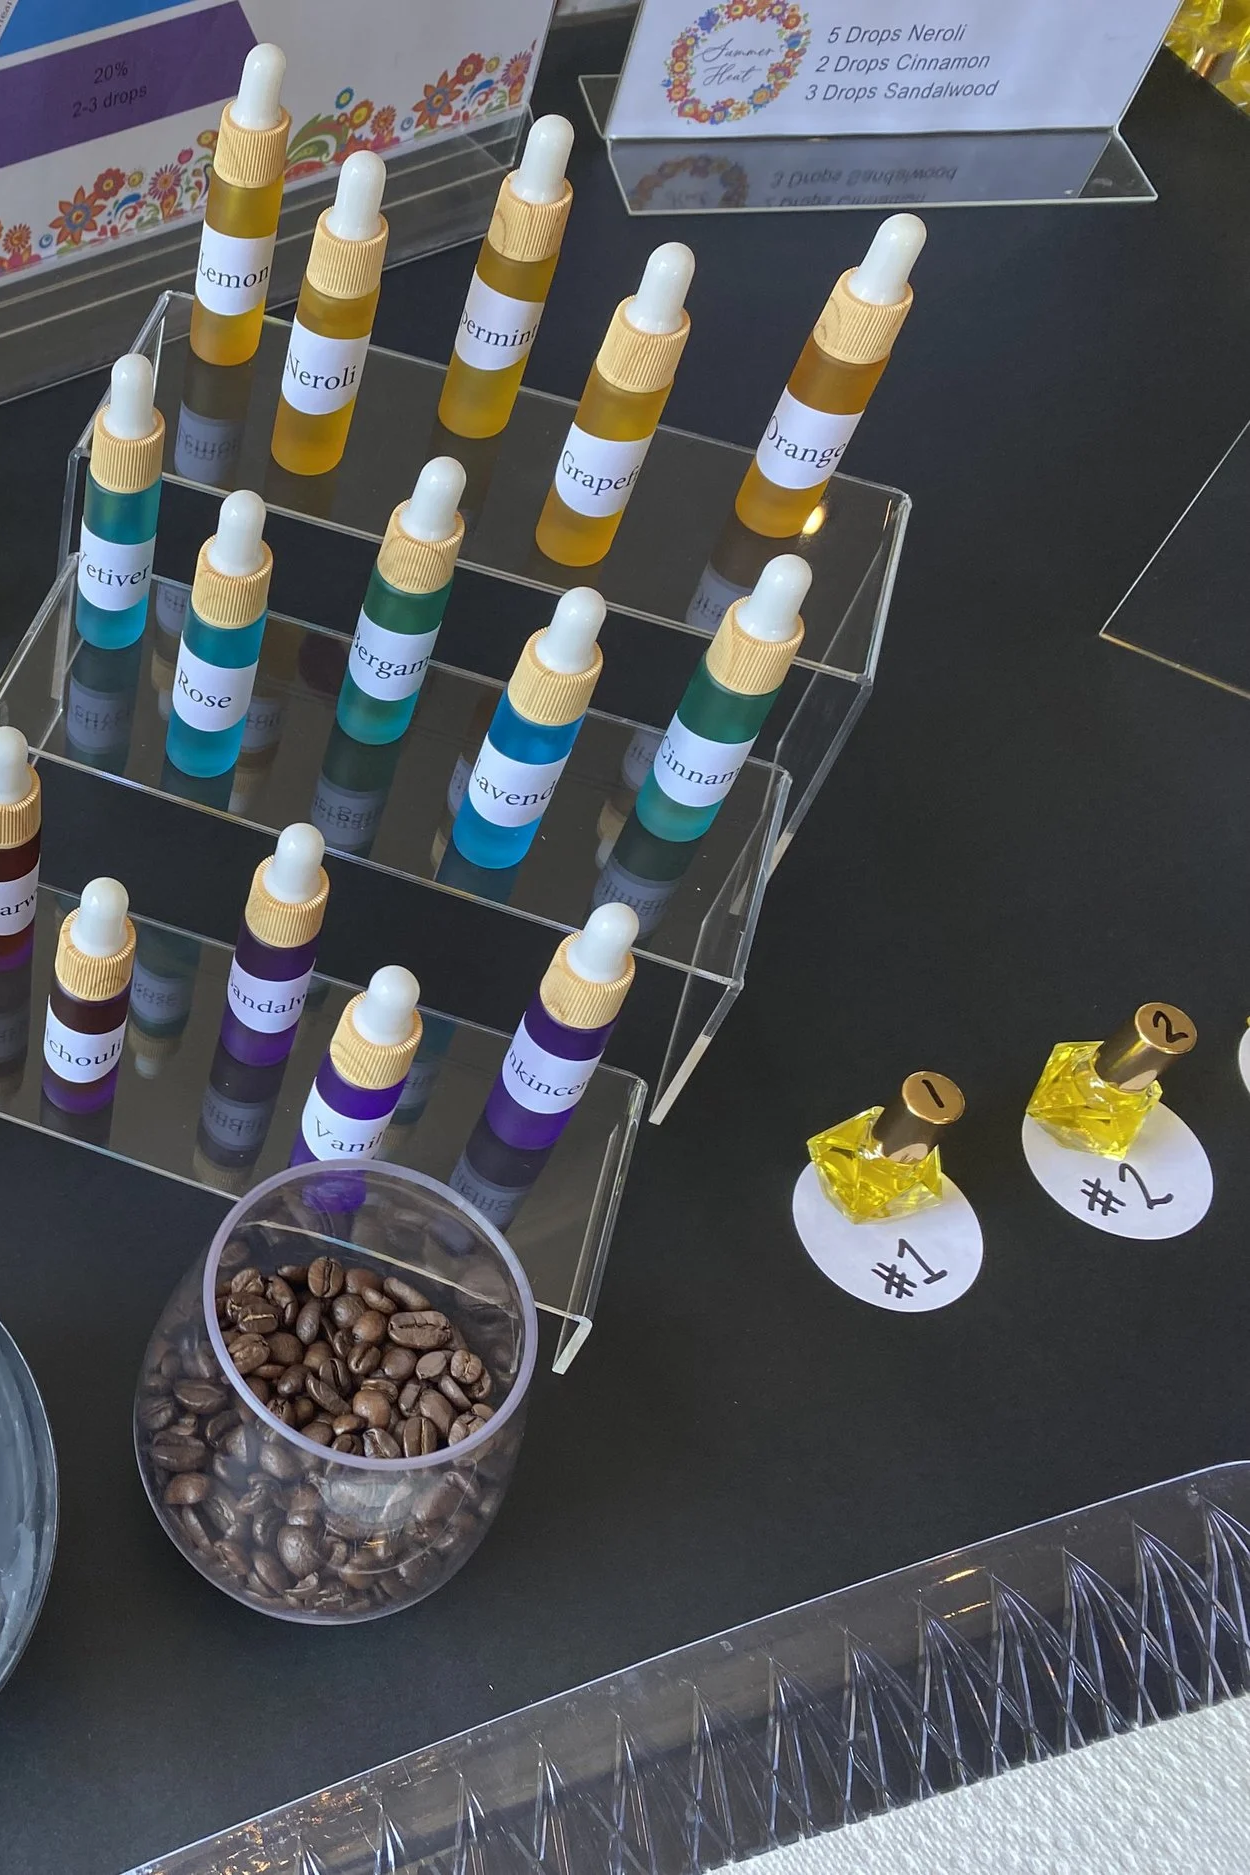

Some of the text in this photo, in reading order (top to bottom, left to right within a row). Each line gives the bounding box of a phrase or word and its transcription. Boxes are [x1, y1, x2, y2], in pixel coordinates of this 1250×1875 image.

[694, 38, 775, 63] Summer
[828, 23, 967, 46] 5 Drops Neroli
[93, 60, 129, 84] 20%
[702, 62, 762, 87] Heat
[815, 53, 991, 76] 2 Drops Cinnamon
[72, 84, 148, 118] 2-3 drops
[805, 80, 1000, 104] 3 Drops Sandalwood
[199, 252, 270, 289] Lemon
[286, 349, 357, 390] Neroli
[766, 415, 846, 468] Orange
[178, 667, 232, 709] Rose
[475, 758, 556, 806] Lavend
[1152, 1010, 1189, 1043] 2
[921, 1079, 945, 1108] 1
[1081, 1163, 1174, 1216] #2
[871, 1238, 947, 1298] #1
